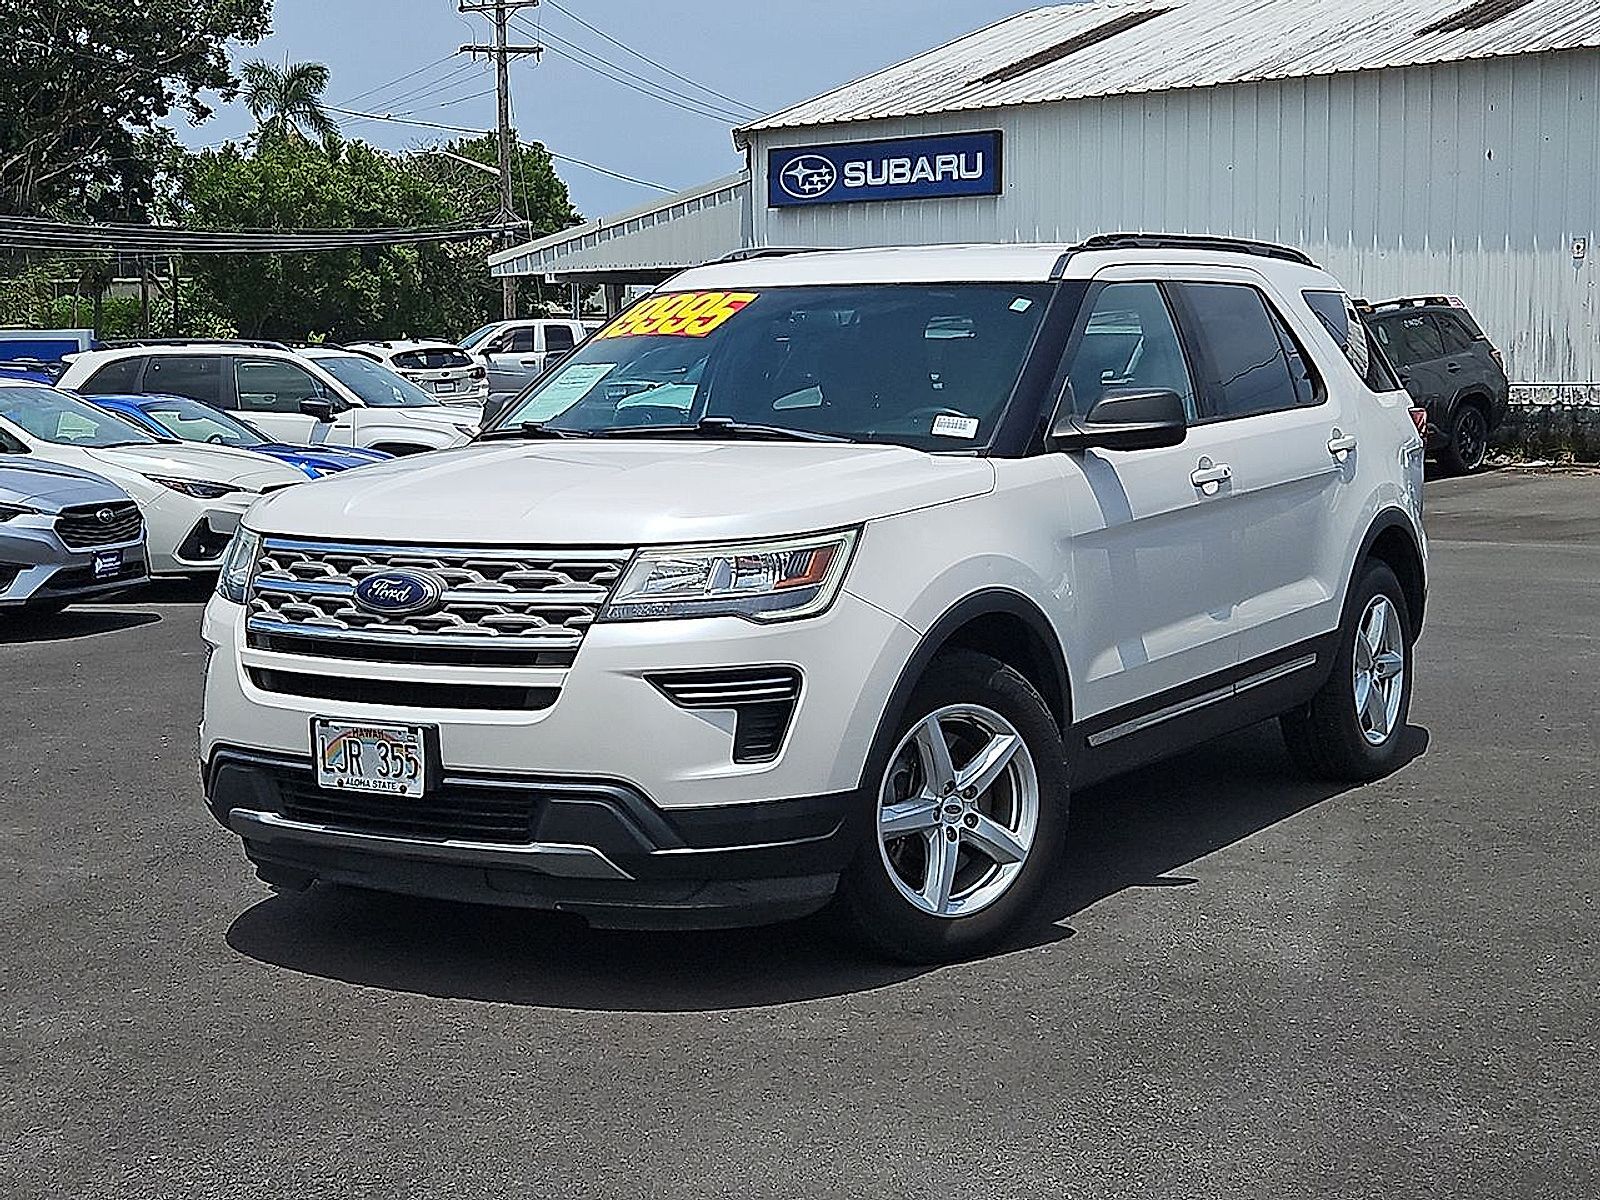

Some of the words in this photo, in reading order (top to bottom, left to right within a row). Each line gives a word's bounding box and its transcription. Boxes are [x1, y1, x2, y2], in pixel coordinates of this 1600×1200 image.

[843, 151, 983, 188] SUBARU
[368, 578, 412, 602] Ford
[352, 727, 384, 740] HAWAII
[320, 735, 363, 776] LJR
[376, 741, 418, 779] 355
[345, 778, 370, 787] ALOHA
[372, 780, 397, 790] STATE
